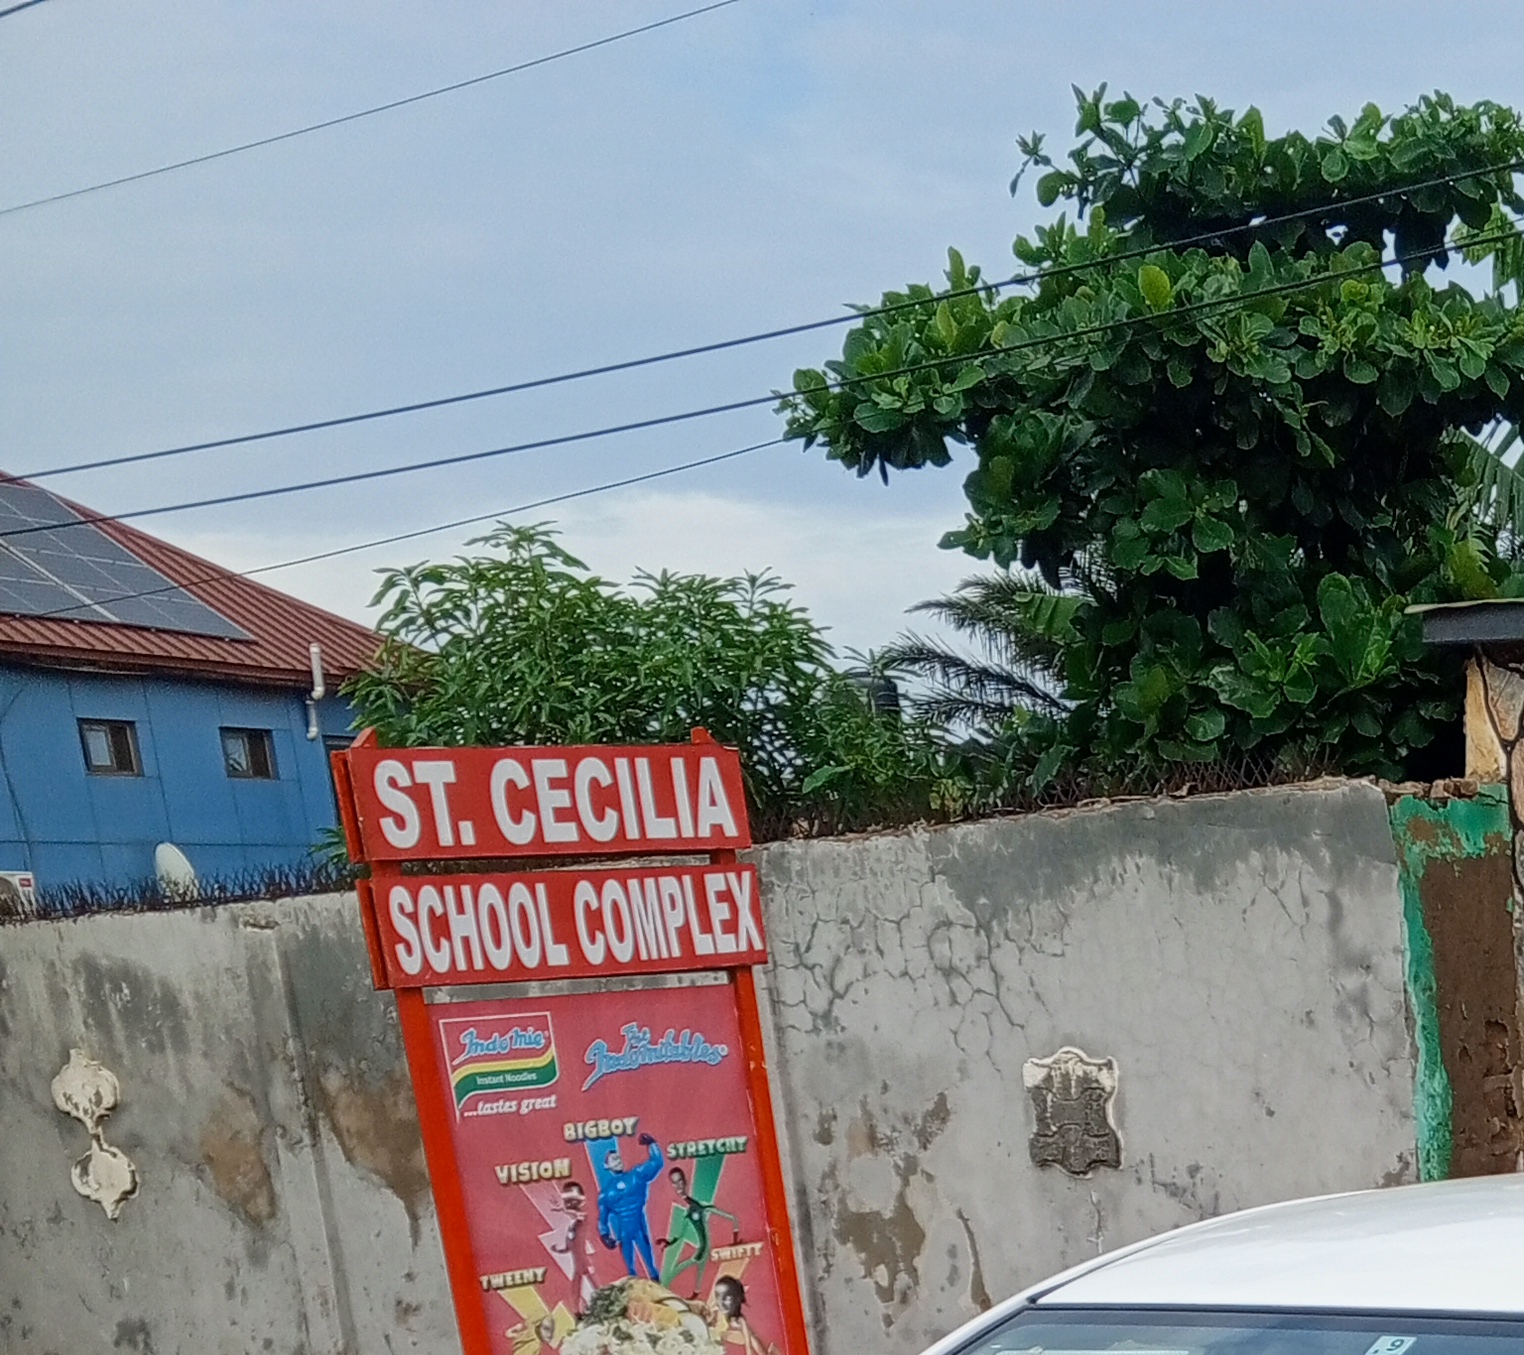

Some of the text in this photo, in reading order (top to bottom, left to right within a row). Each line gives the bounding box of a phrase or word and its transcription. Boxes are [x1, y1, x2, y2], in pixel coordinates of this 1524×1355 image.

[373, 756, 738, 849] ST. CECILIA
[388, 870, 765, 975] SCHOOL COMPLEX
[476, 1071, 537, 1085] Instant Noodles
[519, 1094, 557, 1115] great
[563, 1116, 639, 1141] BIGBOY
[666, 1136, 748, 1160] STRETCHY
[494, 1158, 571, 1184] VISION
[709, 1242, 763, 1262] SWIFTY
[479, 1267, 547, 1291] TWEENY
